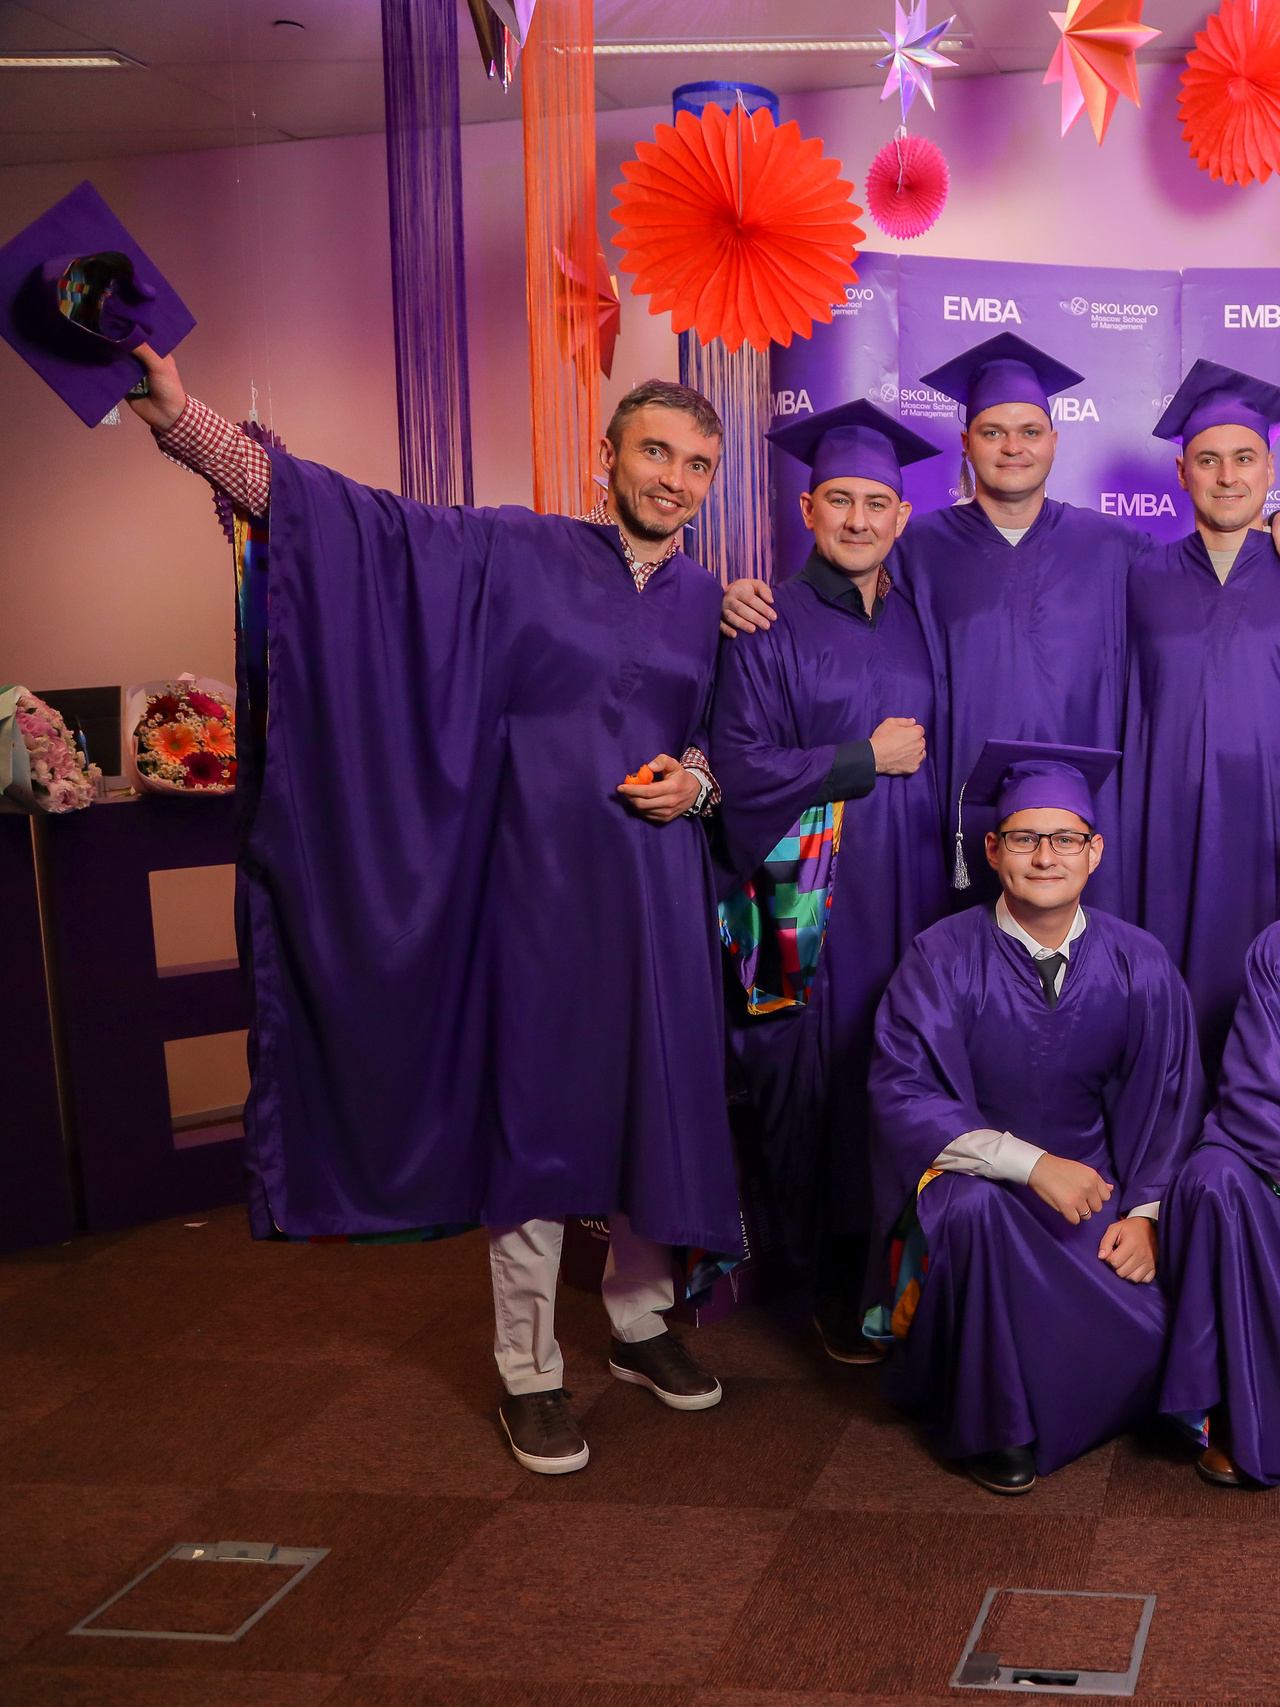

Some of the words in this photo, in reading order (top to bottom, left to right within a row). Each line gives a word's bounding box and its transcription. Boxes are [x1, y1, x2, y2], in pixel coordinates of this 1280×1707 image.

[943, 295, 1022, 324] EMBA
[1090, 302, 1159, 317] SKOLKOVO
[1091, 315, 1121, 323] Moscow
[1122, 315, 1147, 324] School
[1099, 322, 1144, 331] Management
[772, 388, 814, 416] MBA
[900, 389, 957, 403] SKOLKO
[901, 402, 931, 410] Moscow
[932, 402, 958, 411] School
[909, 409, 954, 418] Management
[1050, 397, 1100, 422] MBA
[1100, 492, 1177, 517] EMBA
